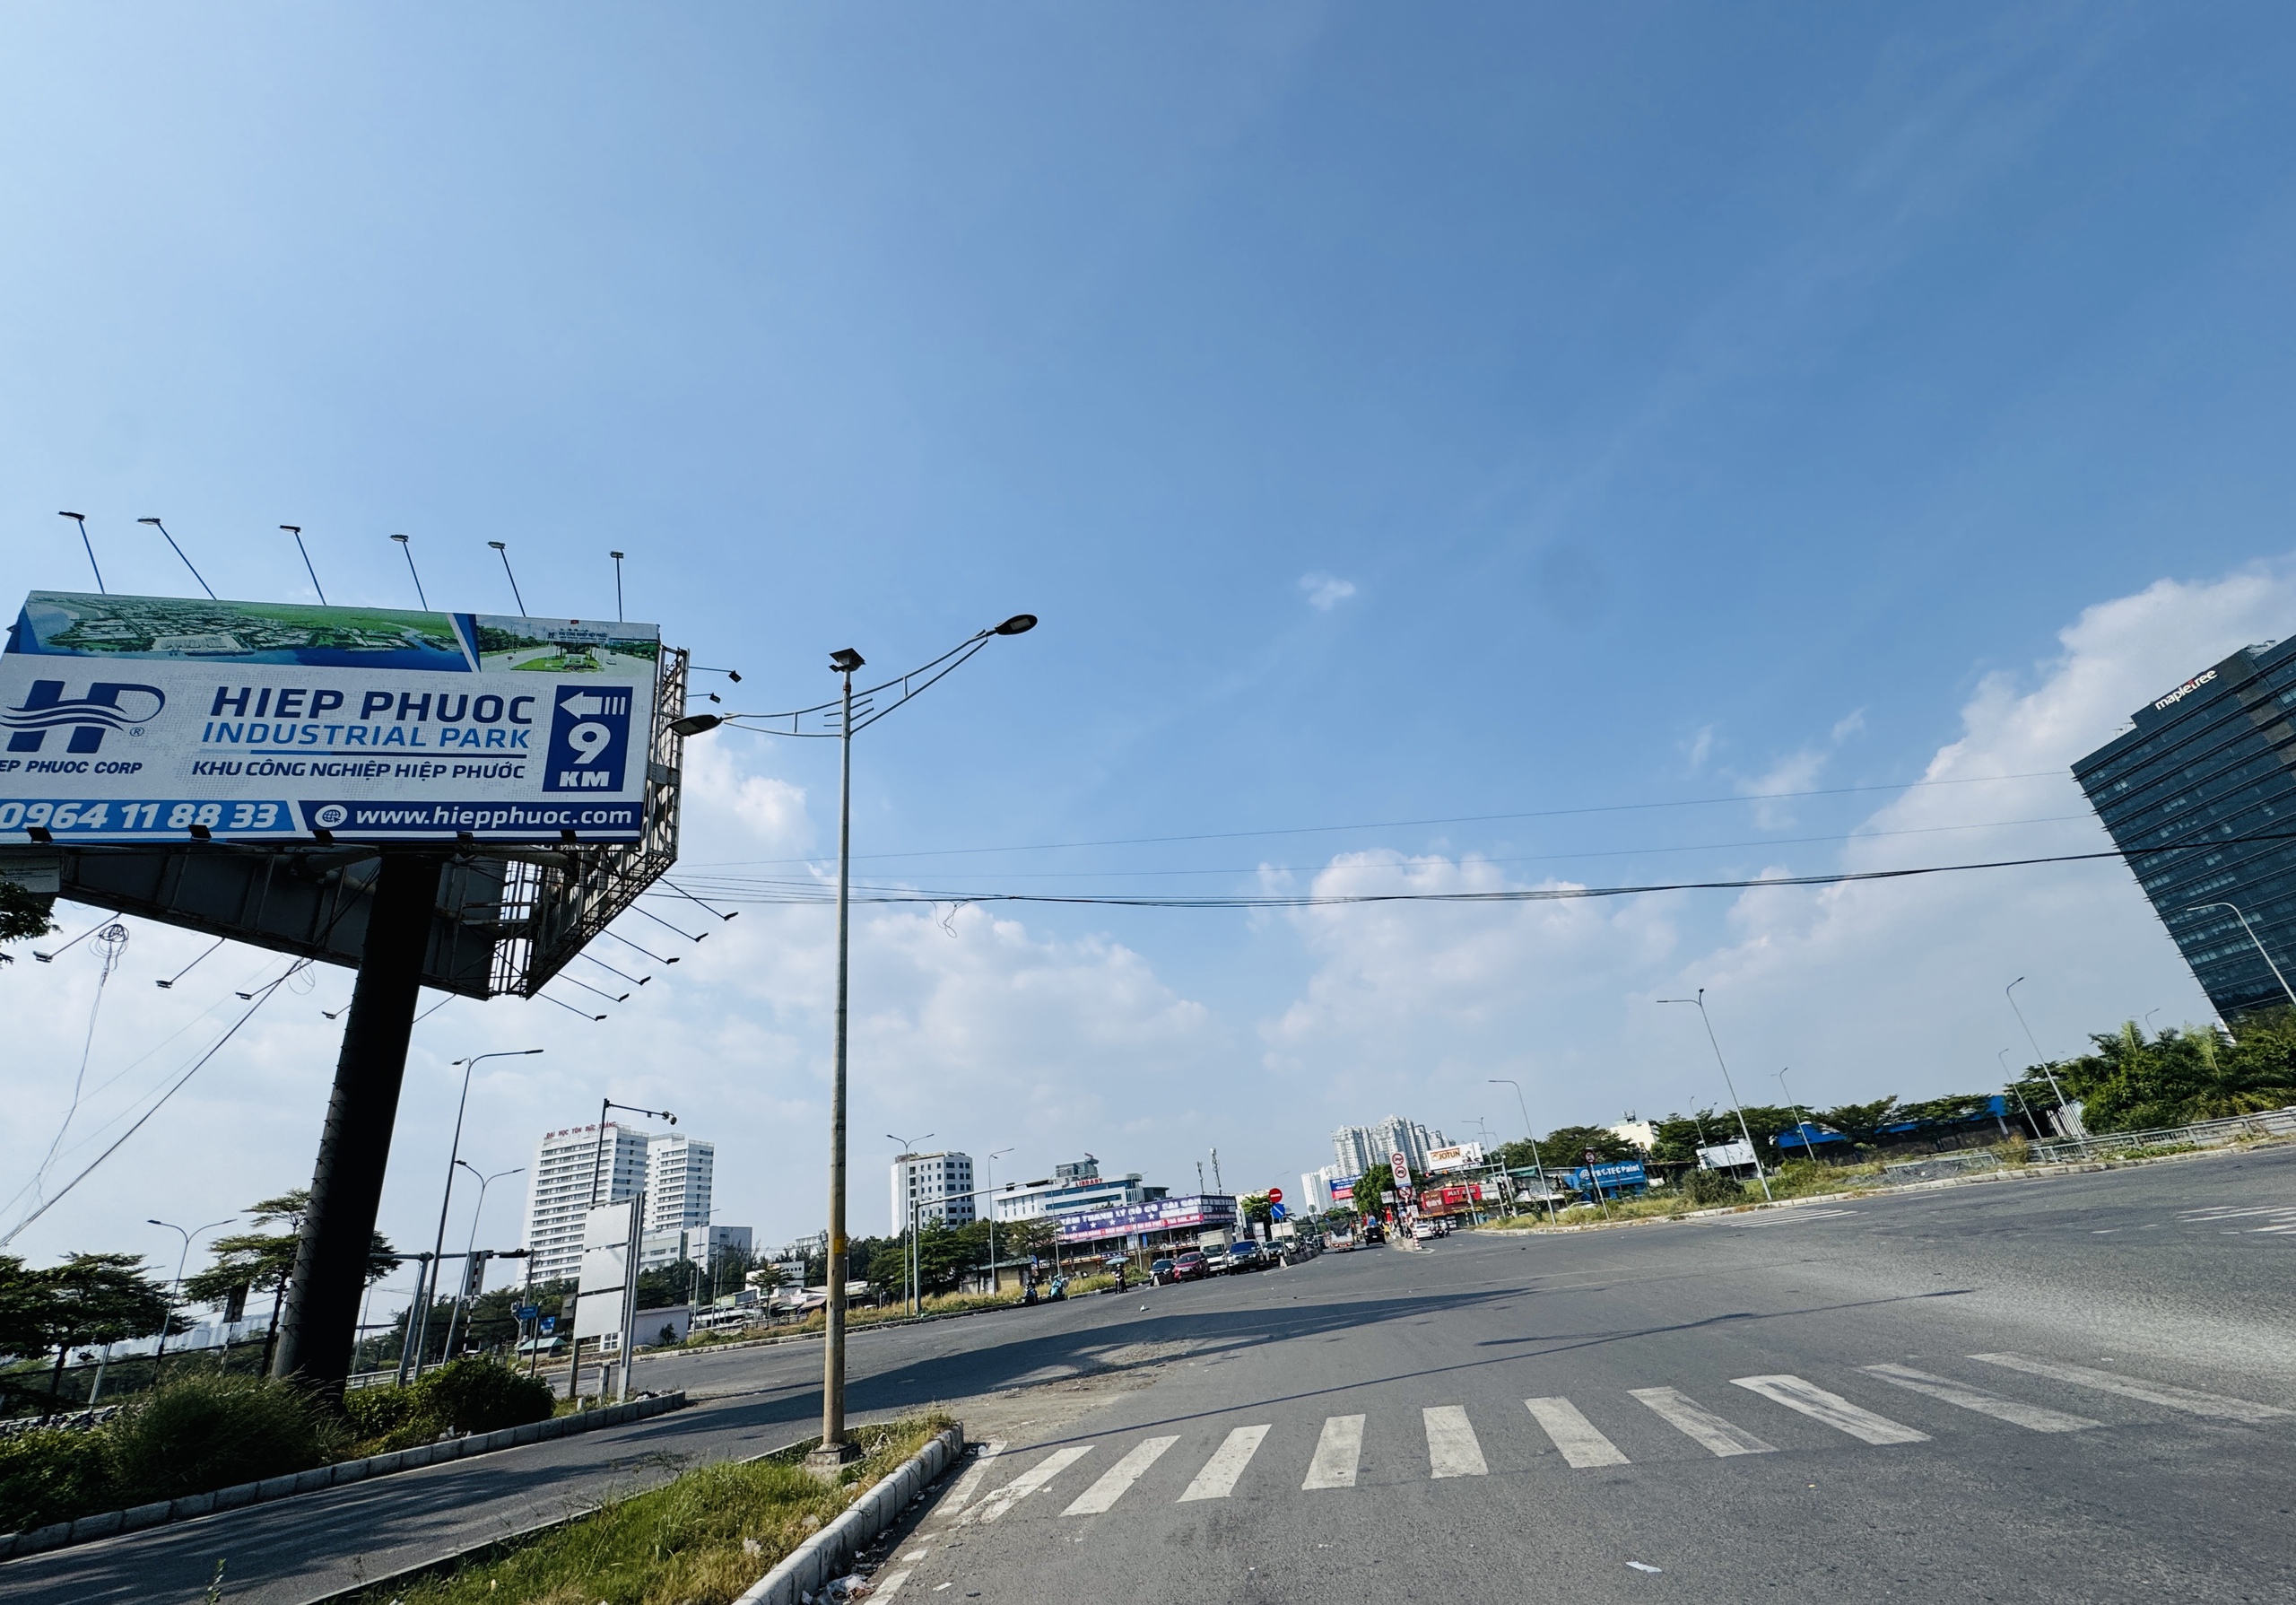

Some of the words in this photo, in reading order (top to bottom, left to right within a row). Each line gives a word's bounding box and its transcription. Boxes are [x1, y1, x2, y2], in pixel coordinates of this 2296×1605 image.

[2154, 670, 2218, 711] mapletree
[210, 686, 344, 719] HIEP
[360, 691, 535, 724] PHUOC
[201, 721, 426, 747] INDUSTRIAL
[439, 727, 530, 749] PARK
[568, 721, 612, 764] 9
[25, 760, 90, 774] PHUOC
[93, 761, 144, 774] CORP
[192, 761, 241, 776] KHU
[245, 758, 307, 777] CÔNG
[309, 760, 391, 781] NGHIỆP
[395, 761, 447, 781] HIỆP
[452, 761, 526, 780] PHƯỚC
[559, 771, 610, 788] KM
[0, 802, 109, 830] 0964
[121, 802, 161, 829] 11
[167, 803, 222, 829] 88
[229, 803, 279, 829] 33
[356, 806, 632, 829] www.hiepphuoc.com
[598, 1120, 616, 1130] TẮNG
[1439, 1150, 1460, 1160] JOTUN
[1622, 1164, 1640, 1173] Paint
[1075, 1178, 1103, 1187] LIBRARY
